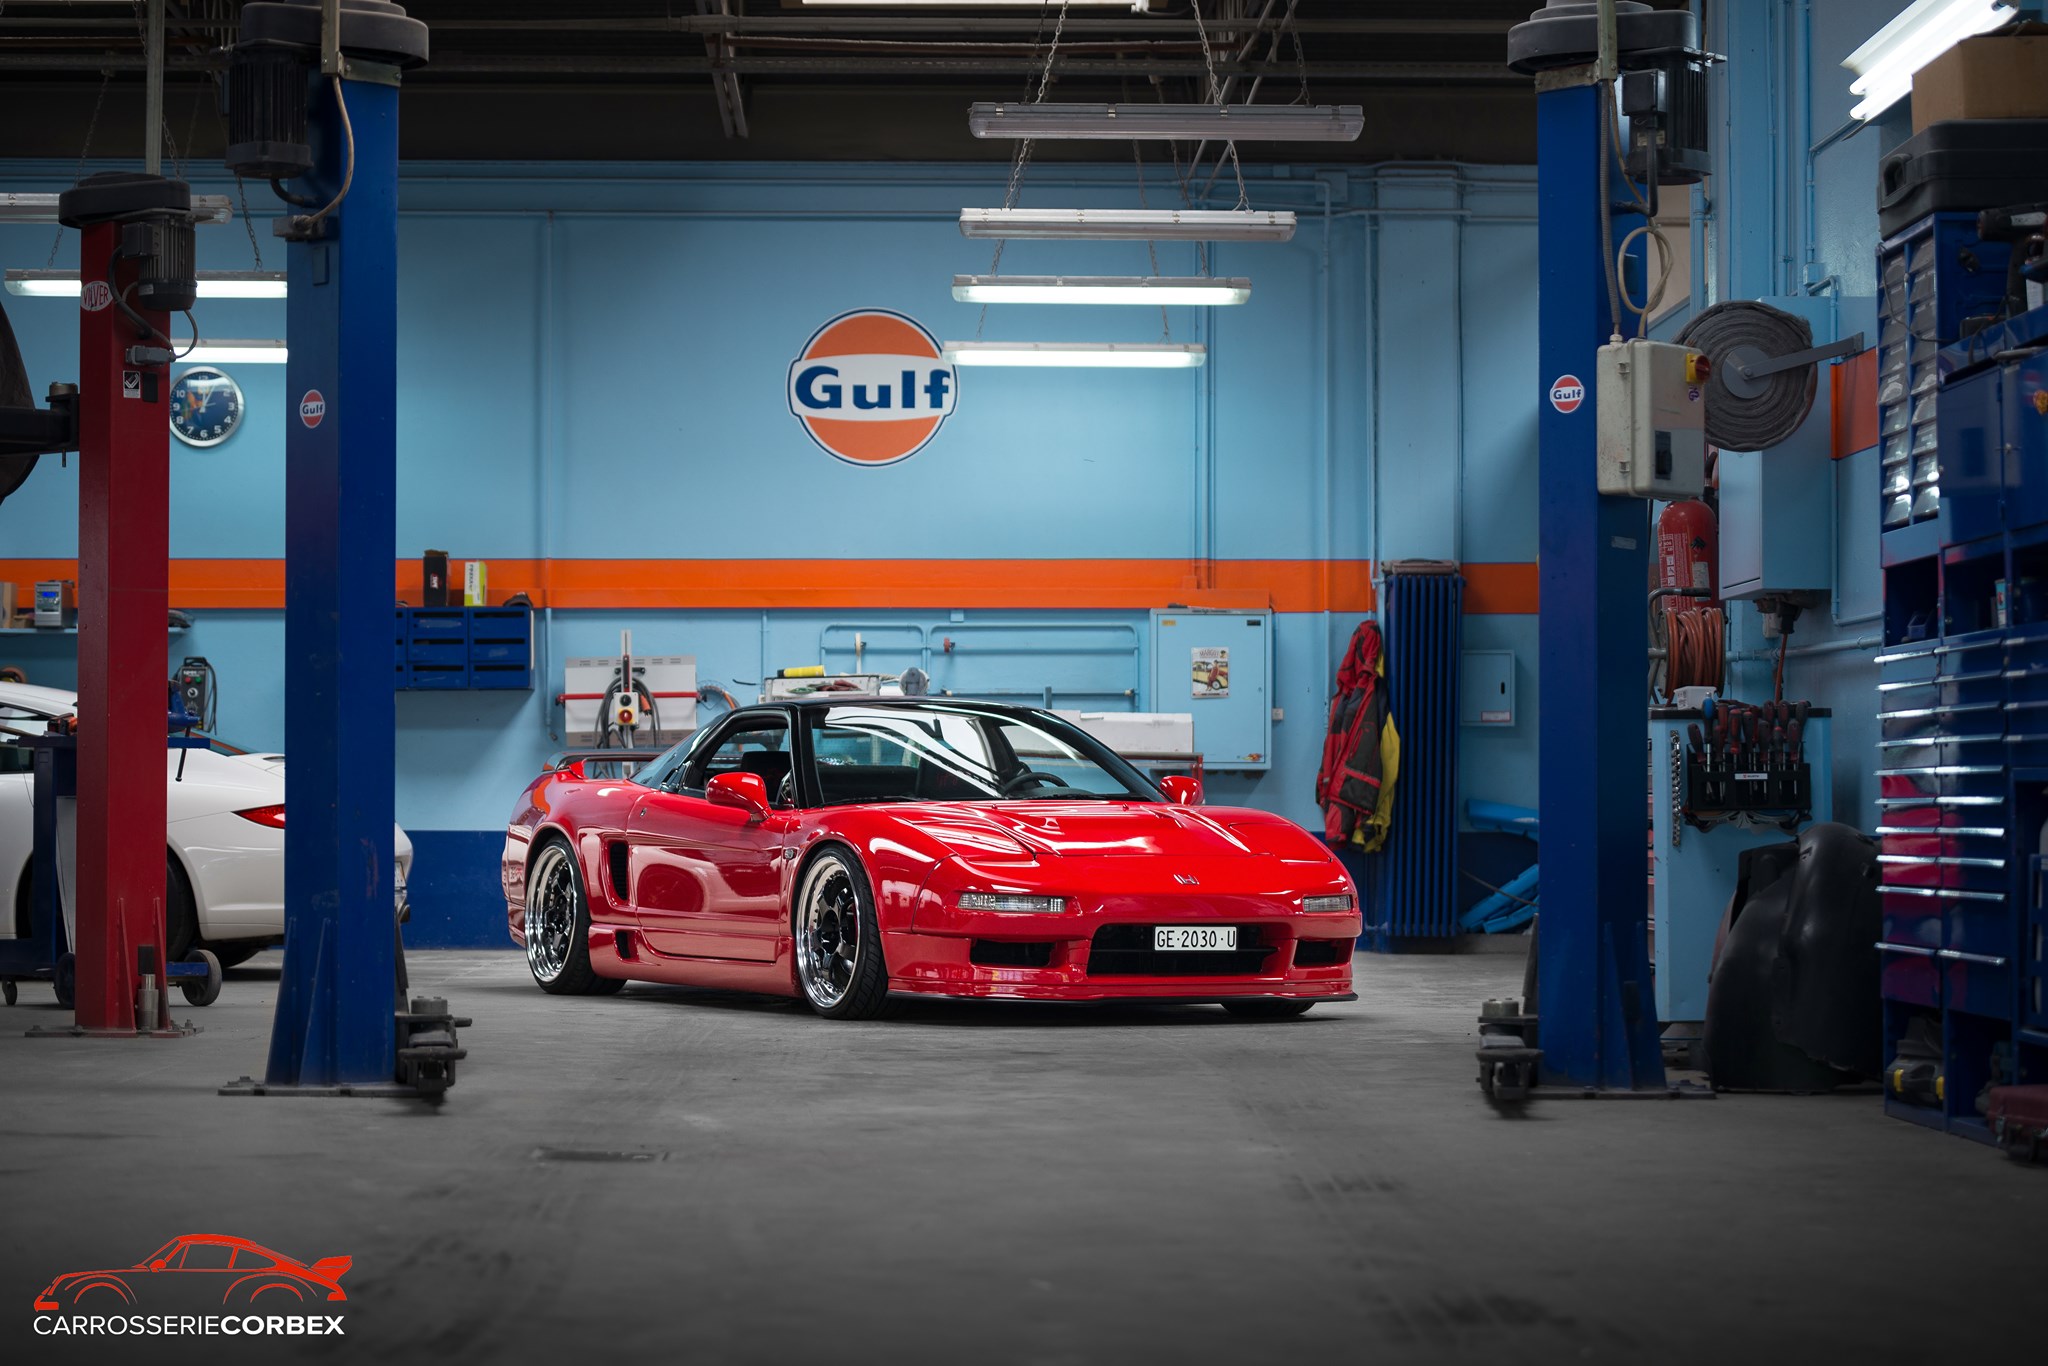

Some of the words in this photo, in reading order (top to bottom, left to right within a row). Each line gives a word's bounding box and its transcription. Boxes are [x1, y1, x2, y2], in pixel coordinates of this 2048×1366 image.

[795, 366, 951, 410] Gulf
[176, 390, 186, 398] 10
[1553, 389, 1582, 400] Gulf
[172, 403, 181, 411] 9
[228, 402, 235, 411] 3
[302, 404, 324, 414] Gulf
[176, 416, 184, 425] 8
[224, 415, 232, 424] 4
[187, 426, 194, 434] 7
[200, 429, 208, 438] 6
[214, 425, 222, 433] 5
